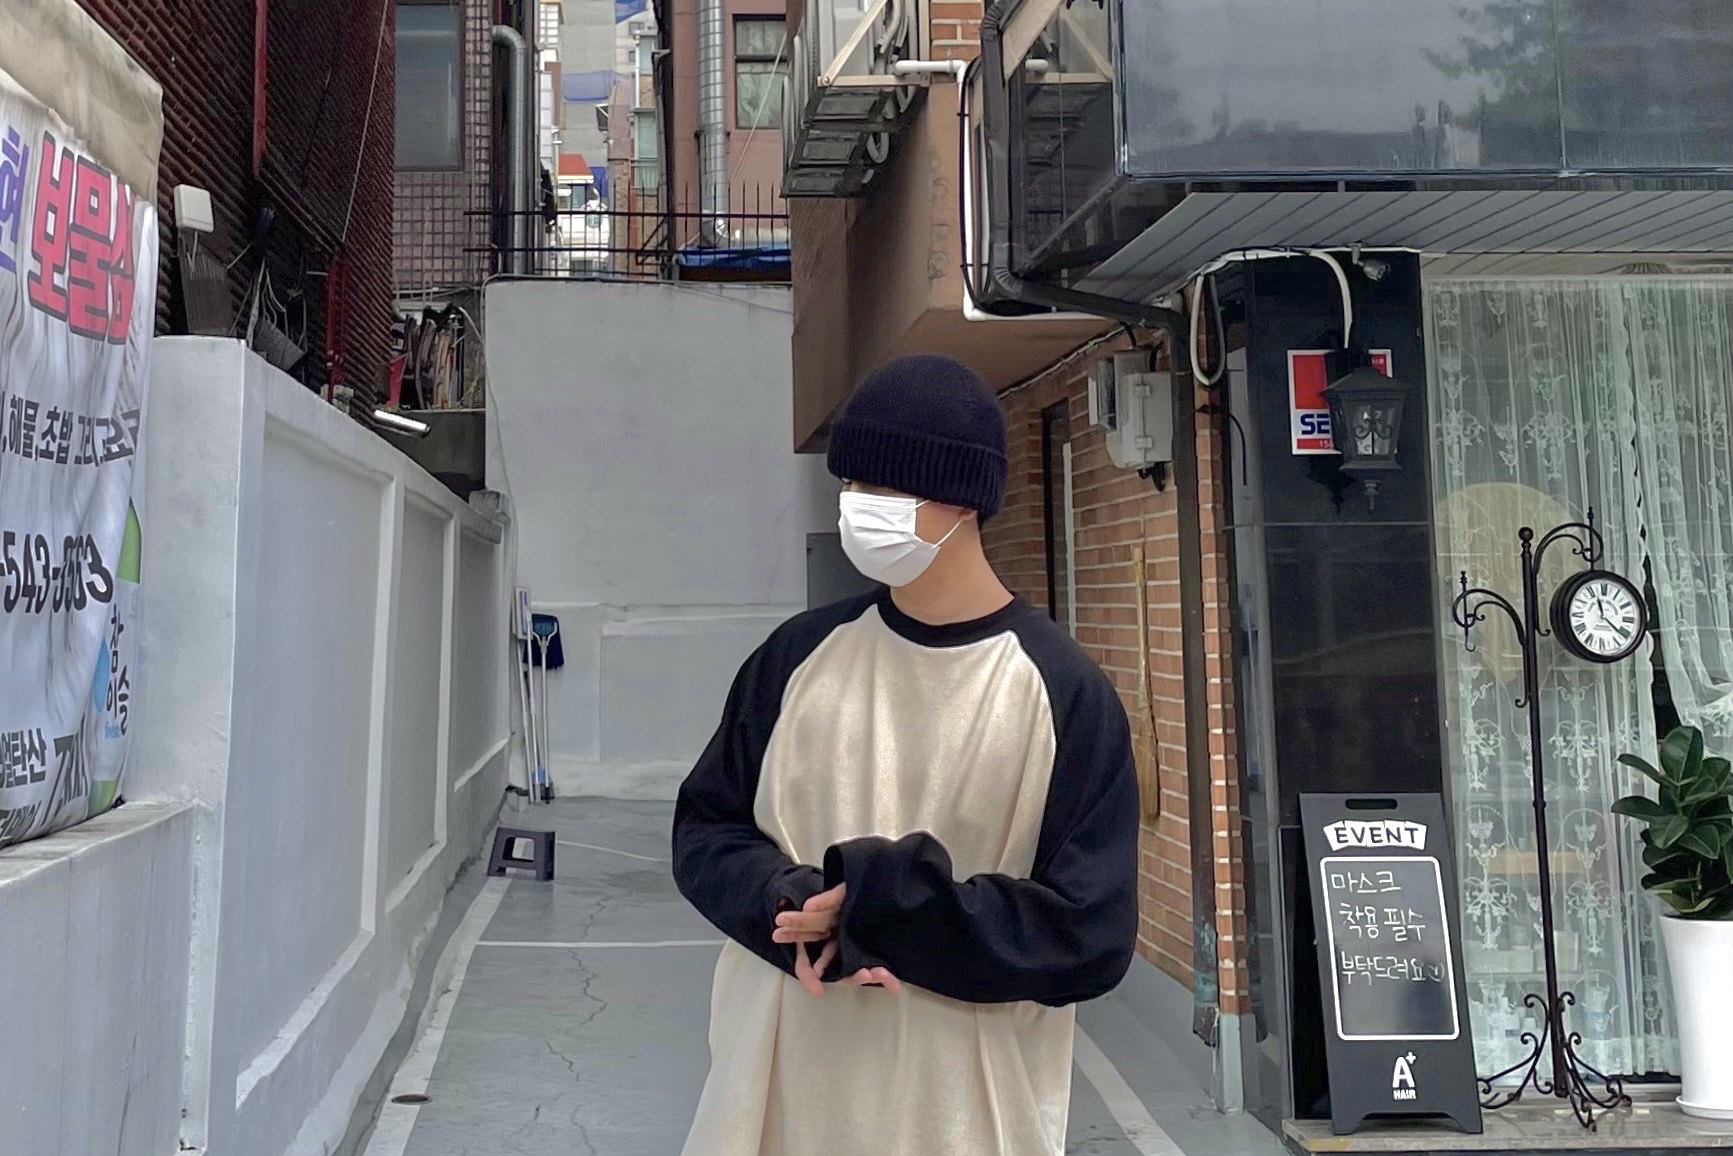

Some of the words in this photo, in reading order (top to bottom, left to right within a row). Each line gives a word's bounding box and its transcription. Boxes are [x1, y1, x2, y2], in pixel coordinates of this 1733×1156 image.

[27, 130, 136, 345] 보물섬
[1300, 413, 1330, 435] SE
[1333, 826, 1420, 844] EVENT
[1330, 871, 1402, 893] 마스크
[1339, 903, 1379, 939] 착용
[1383, 907, 1426, 942] 필수
[1340, 951, 1427, 985] 부탁드려요
[1393, 1090, 1417, 1101] HAIR
